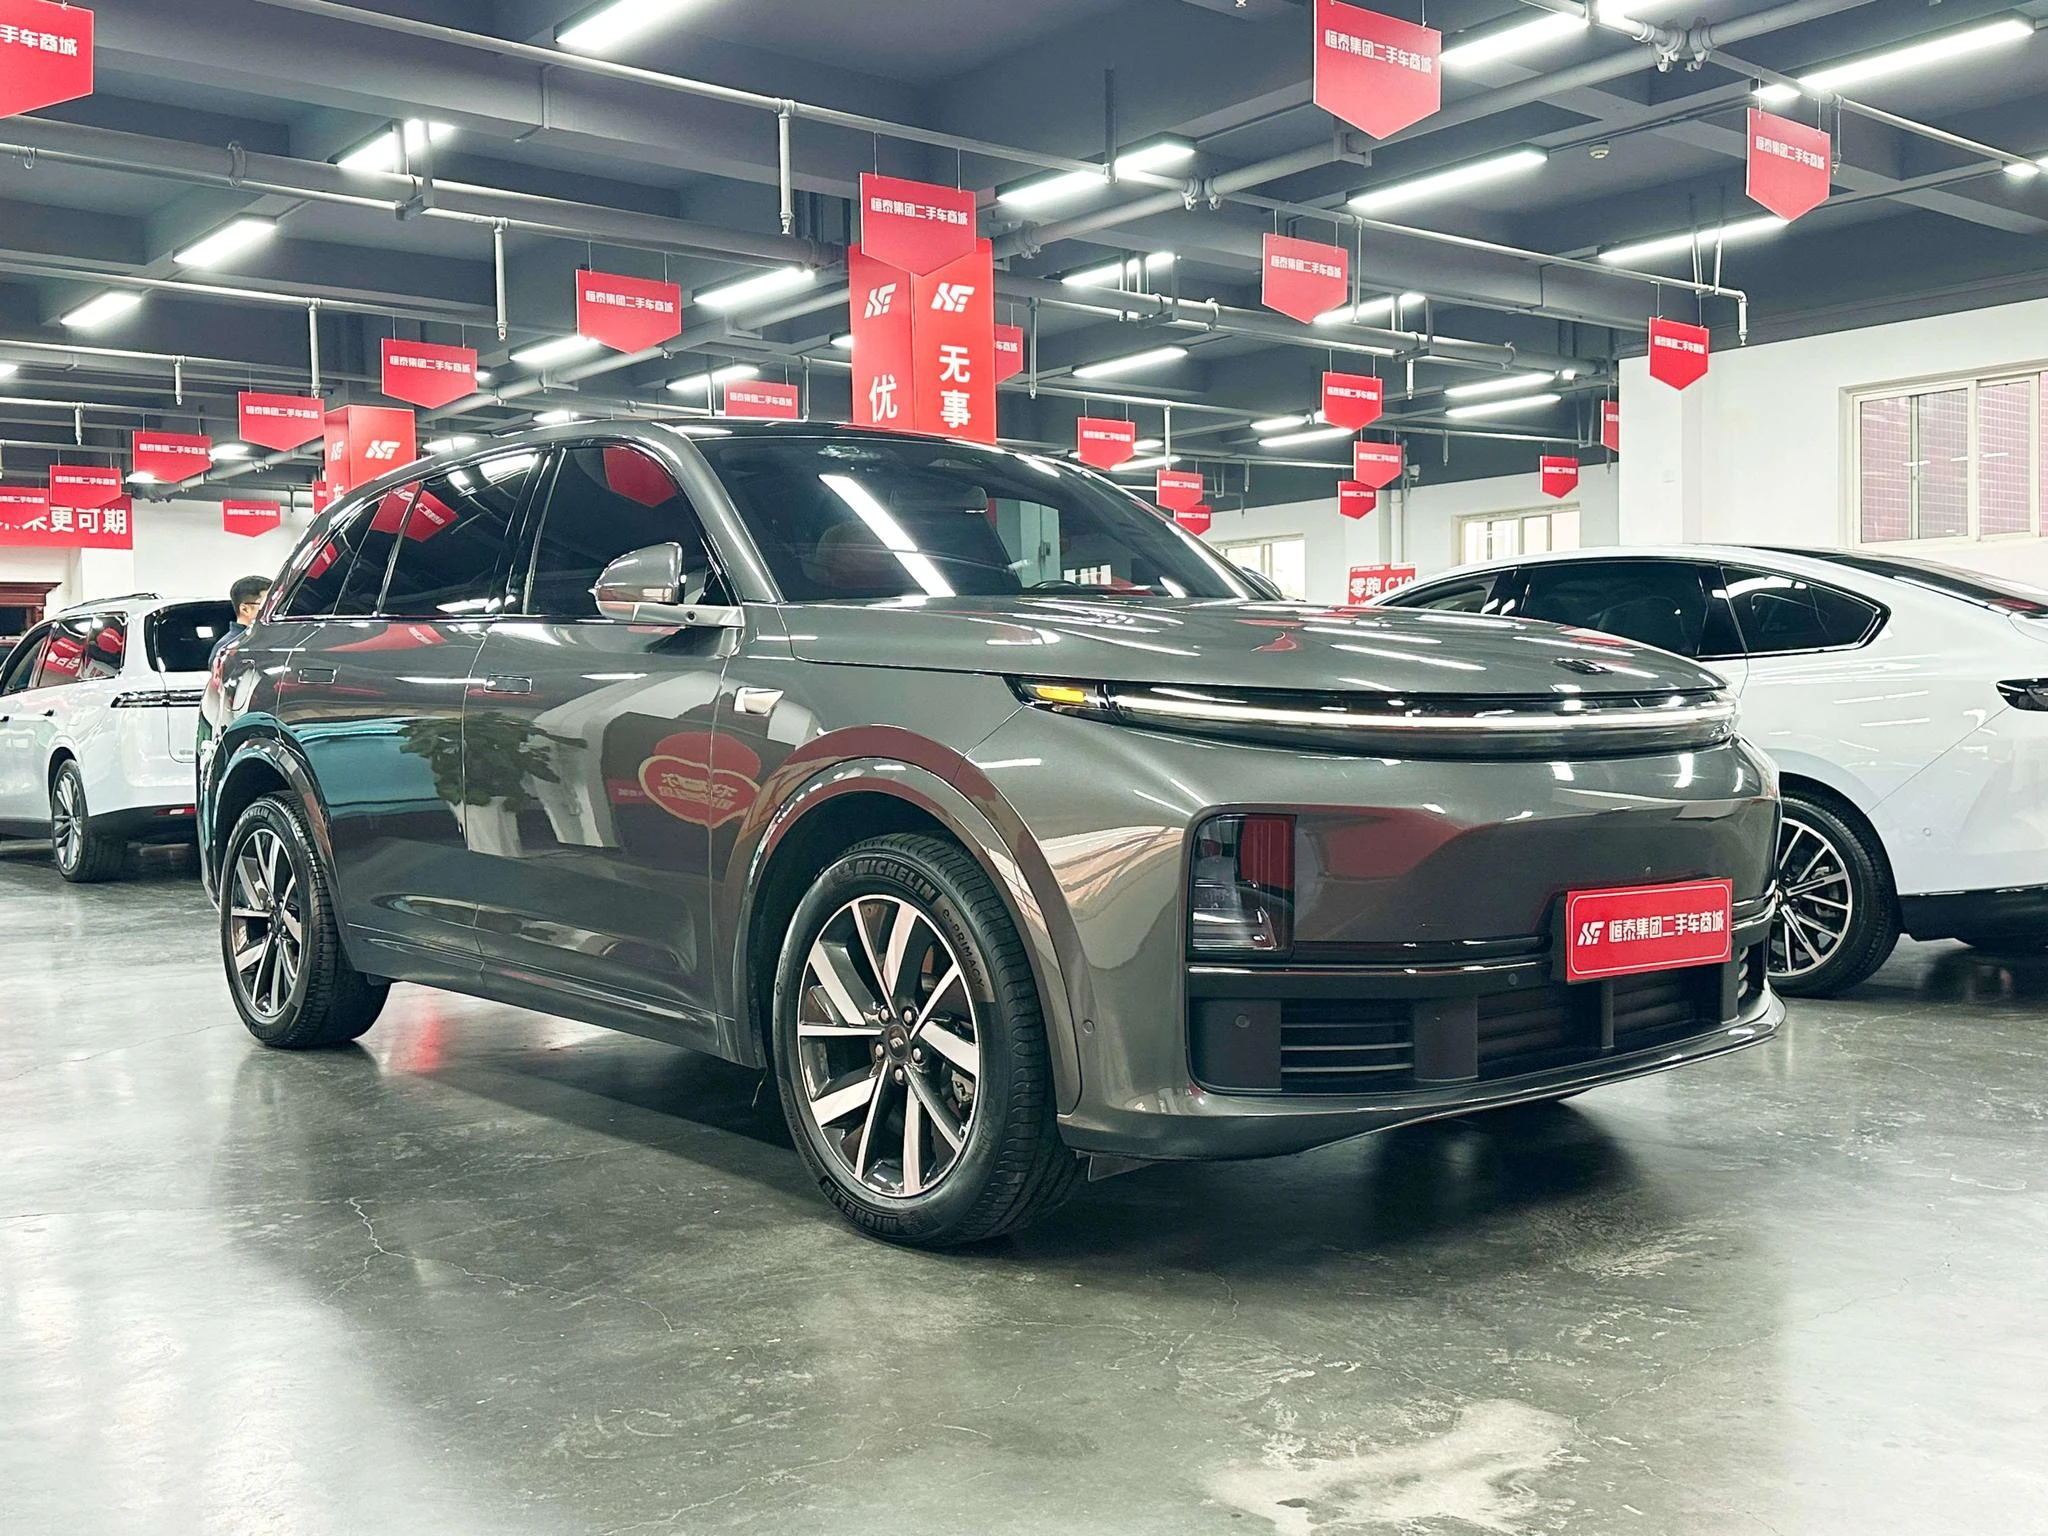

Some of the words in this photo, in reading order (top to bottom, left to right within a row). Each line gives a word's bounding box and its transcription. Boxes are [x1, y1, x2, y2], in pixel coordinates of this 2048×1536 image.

[1325, 29, 1432, 74] 恒泰集团二手车商城
[1756, 135, 1825, 170] 恒泰集团二手车商城
[871, 197, 968, 226] 恒泰集团二手车商城
[1271, 255, 1342, 278] 恒泰集团二手车商城
[586, 290, 674, 313] 恒泰集团二手车商城
[868, 373, 898, 423] 优
[855, 859, 937, 901] MICHELIN
[1608, 910, 1725, 943] 恒泰集团二手车商城
